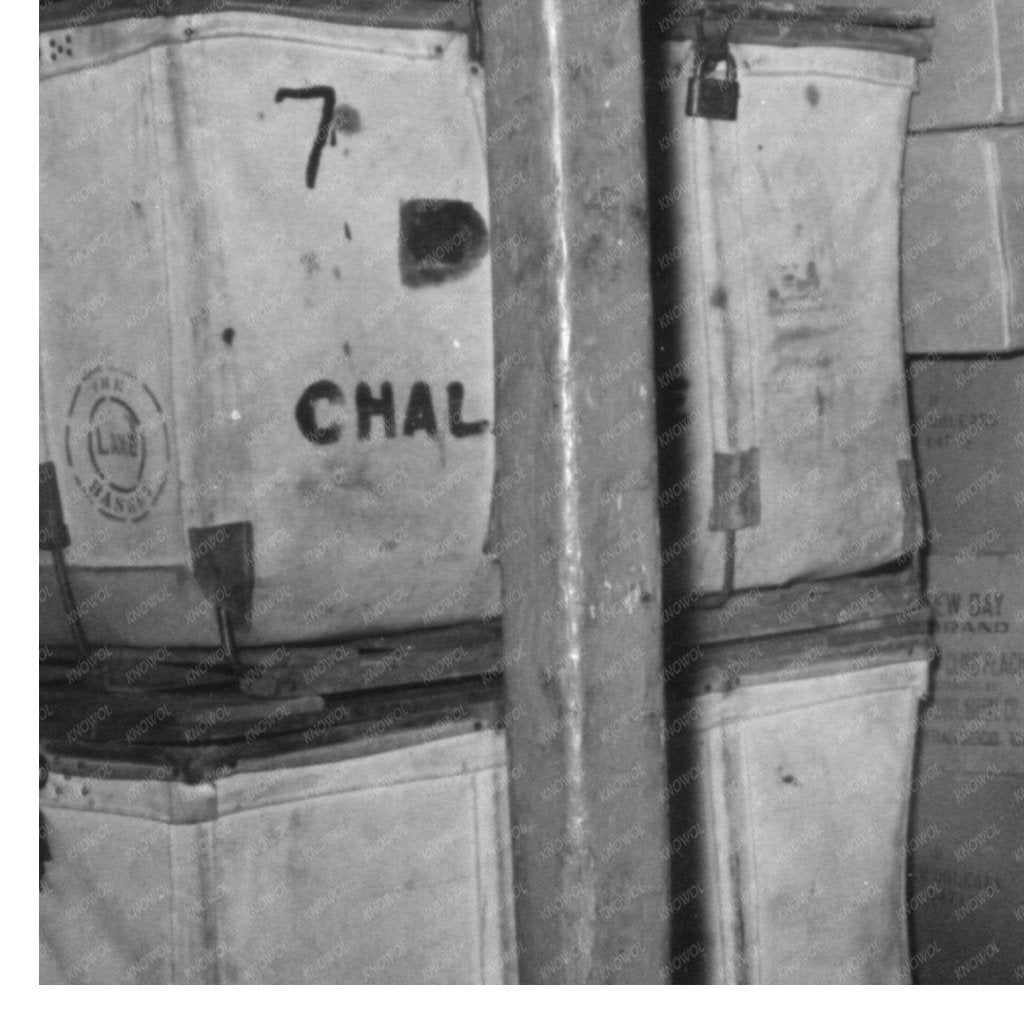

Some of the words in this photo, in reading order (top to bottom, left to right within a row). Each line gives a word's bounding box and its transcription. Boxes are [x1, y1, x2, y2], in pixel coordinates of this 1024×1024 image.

[274, 85, 336, 189] 7
[295, 380, 493, 446] CHAL
[932, 593, 961, 617] EW
[969, 592, 1004, 617] DAY
